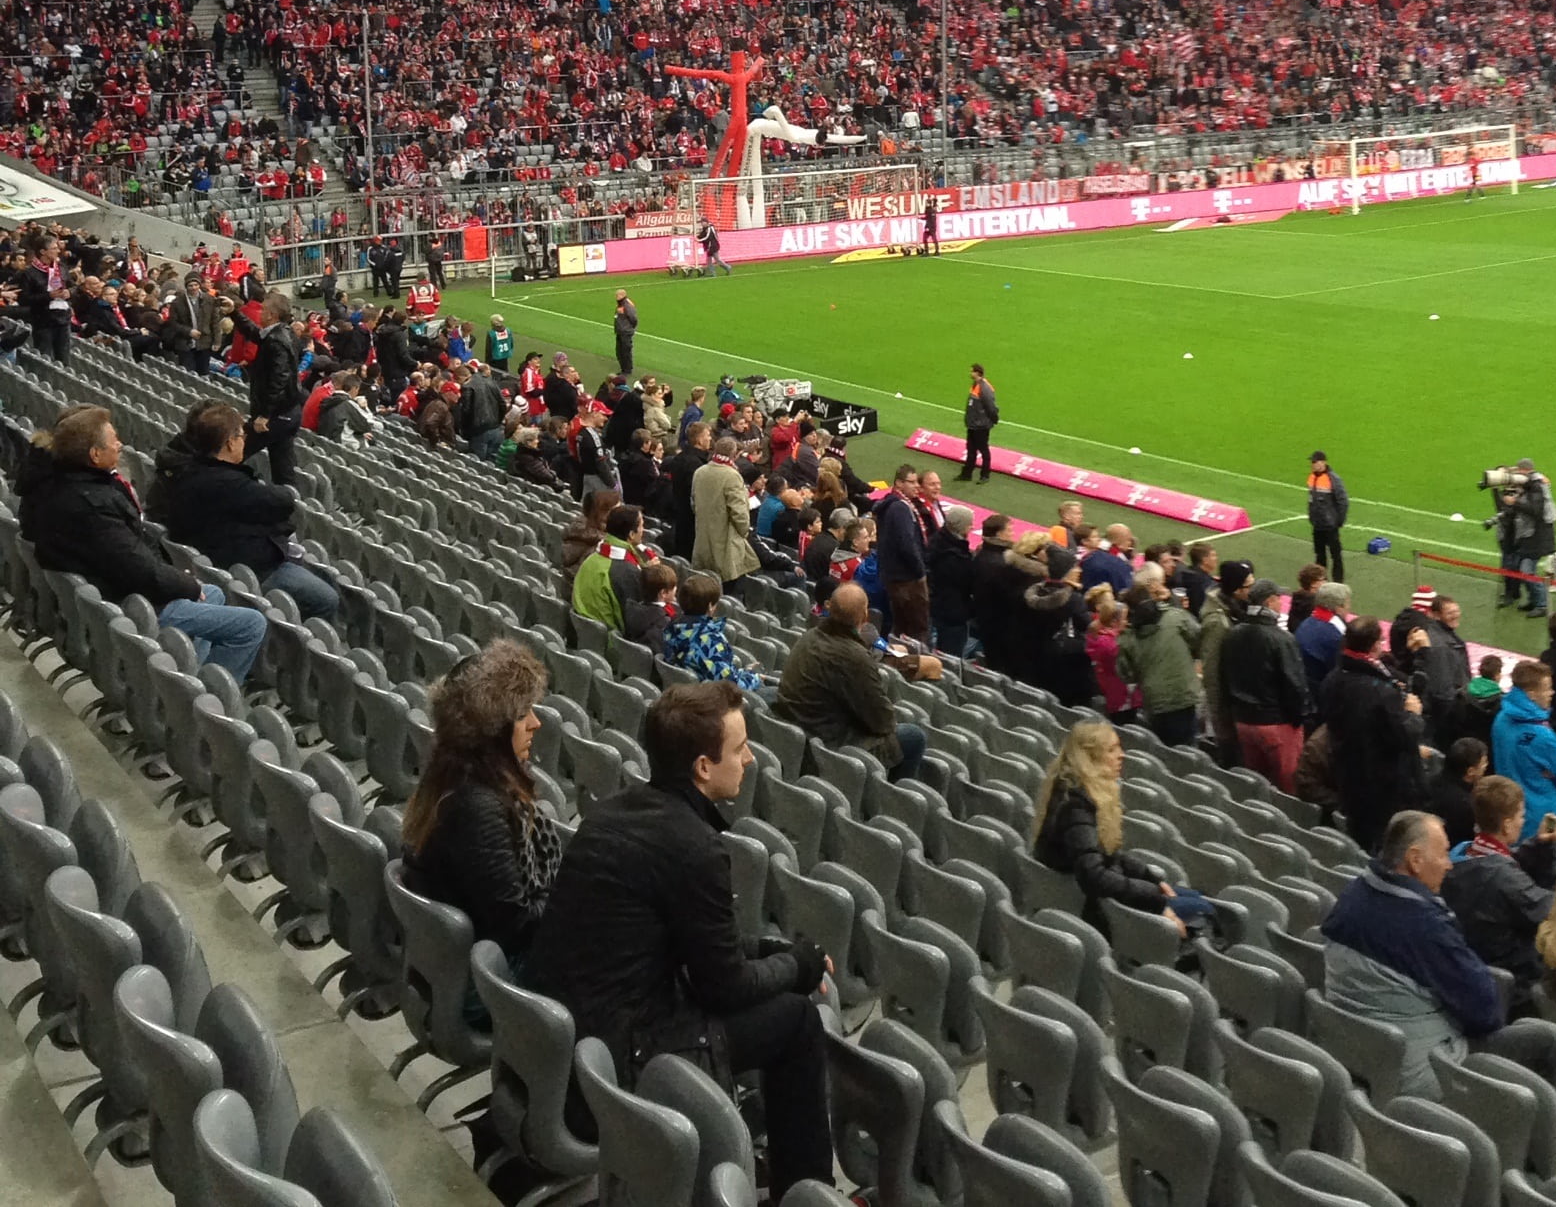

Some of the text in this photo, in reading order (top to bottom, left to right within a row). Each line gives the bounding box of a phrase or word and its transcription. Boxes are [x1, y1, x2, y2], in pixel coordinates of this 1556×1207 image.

[636, 213, 673, 228] Allgäu
[779, 229, 829, 253] AUF
[834, 223, 886, 249] SKY
[813, 398, 829, 418] sky
[838, 416, 865, 434] sky
